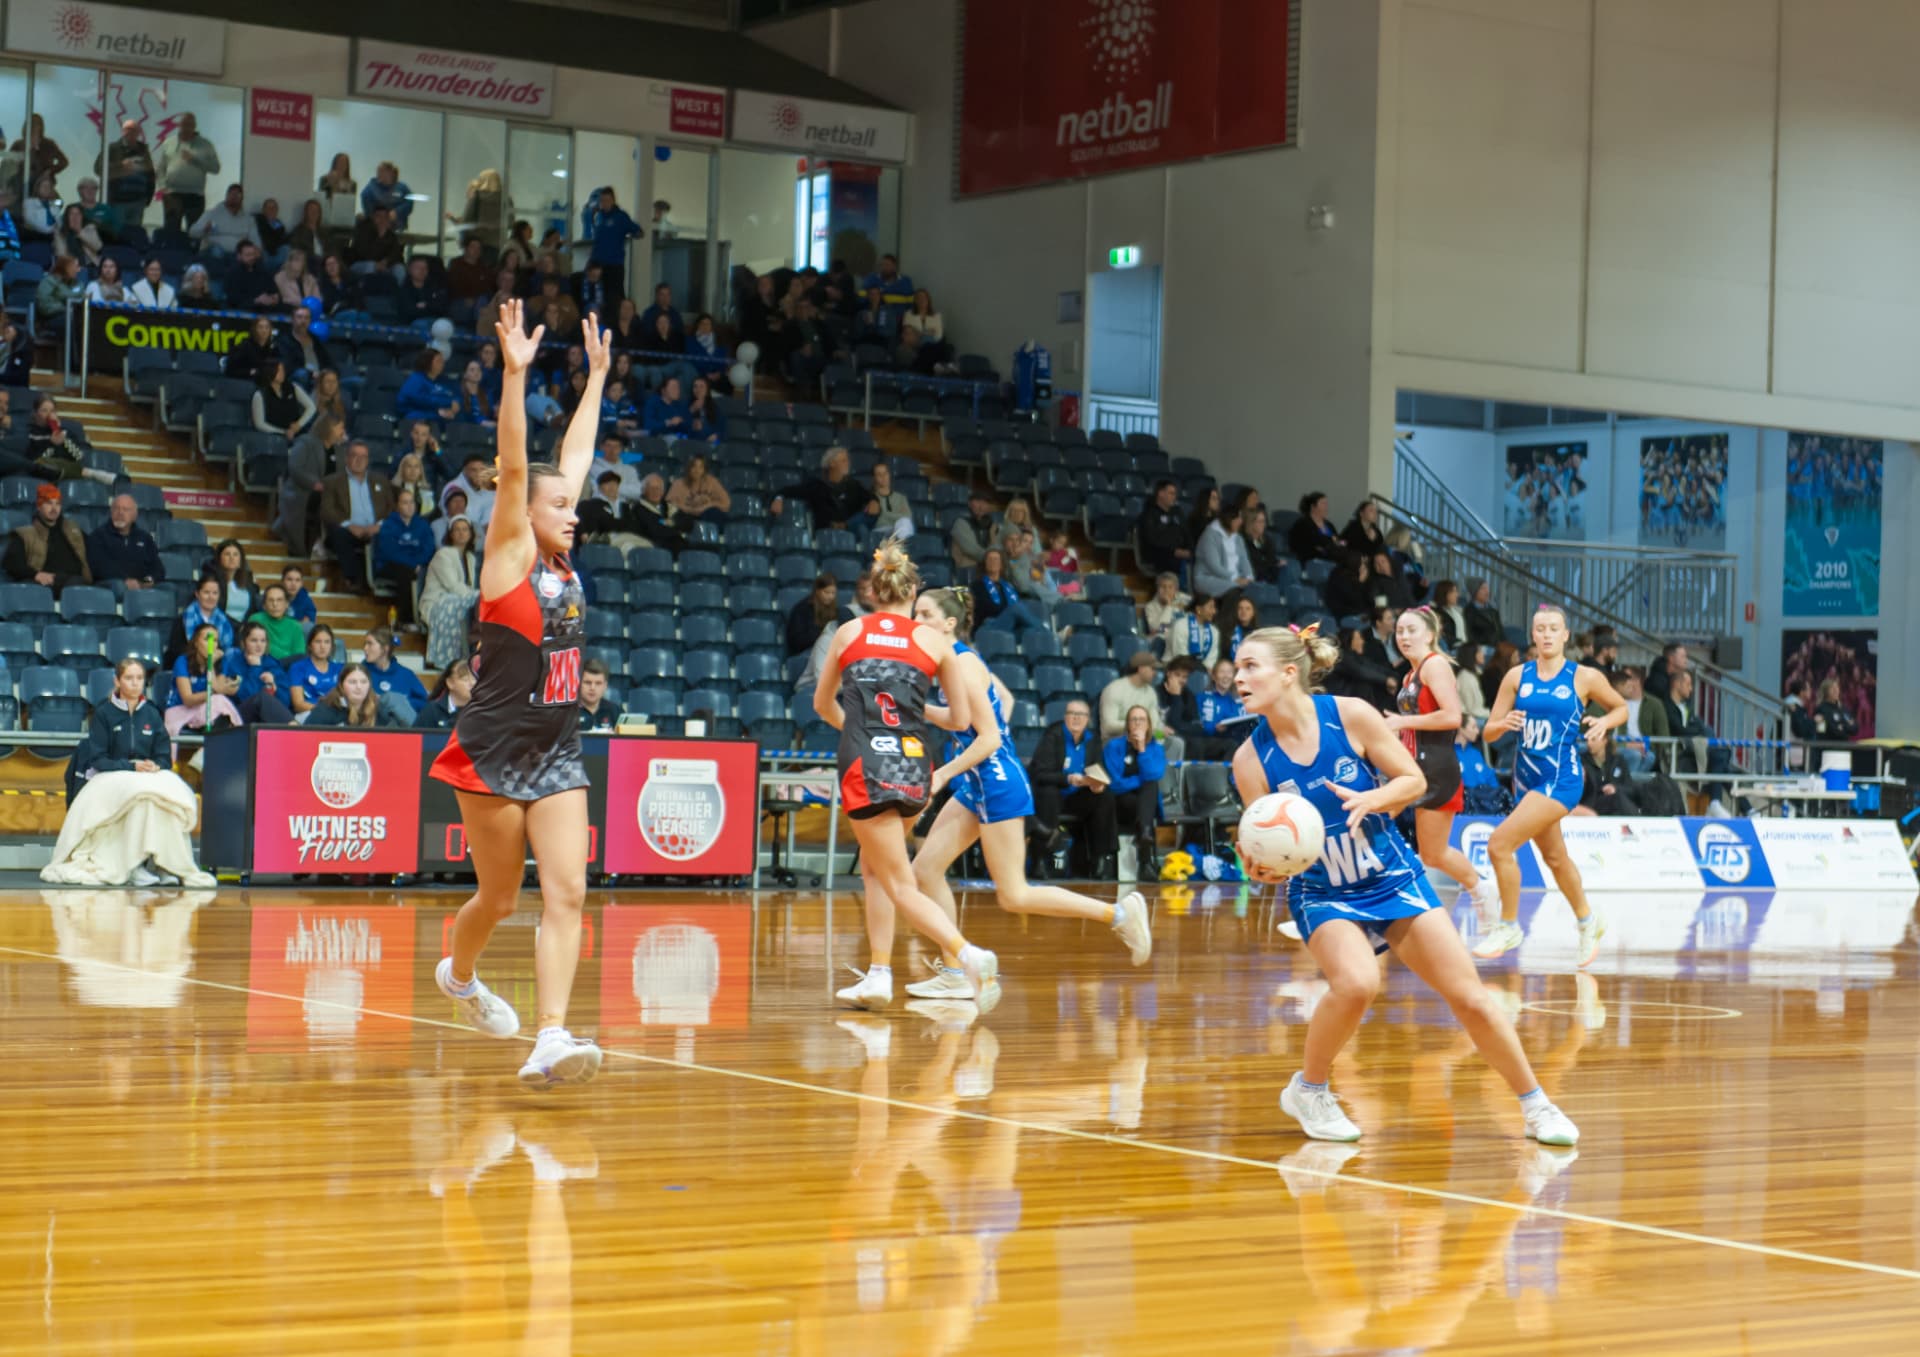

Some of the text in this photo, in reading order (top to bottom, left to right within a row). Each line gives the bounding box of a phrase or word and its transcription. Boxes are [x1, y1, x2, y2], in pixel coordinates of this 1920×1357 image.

[96, 33, 186, 60] netball
[416, 52, 497, 73] ADELAIDE
[365, 61, 546, 105] Thunderbirds
[255, 98, 308, 118] WEST 4
[674, 96, 710, 113] WEST
[1056, 81, 1173, 146] netball
[805, 124, 876, 147] netball
[1815, 561, 1848, 579] 2010
[1807, 580, 1852, 590] CHAMPIONS
[874, 691, 901, 727] C
[648, 802, 713, 818] PREMIER
[288, 815, 386, 839] WITNESS
[653, 819, 706, 835] LEAGUE
[298, 832, 375, 864] Fierce
[1319, 827, 1385, 887] WA
[1697, 841, 1748, 868] JETS
